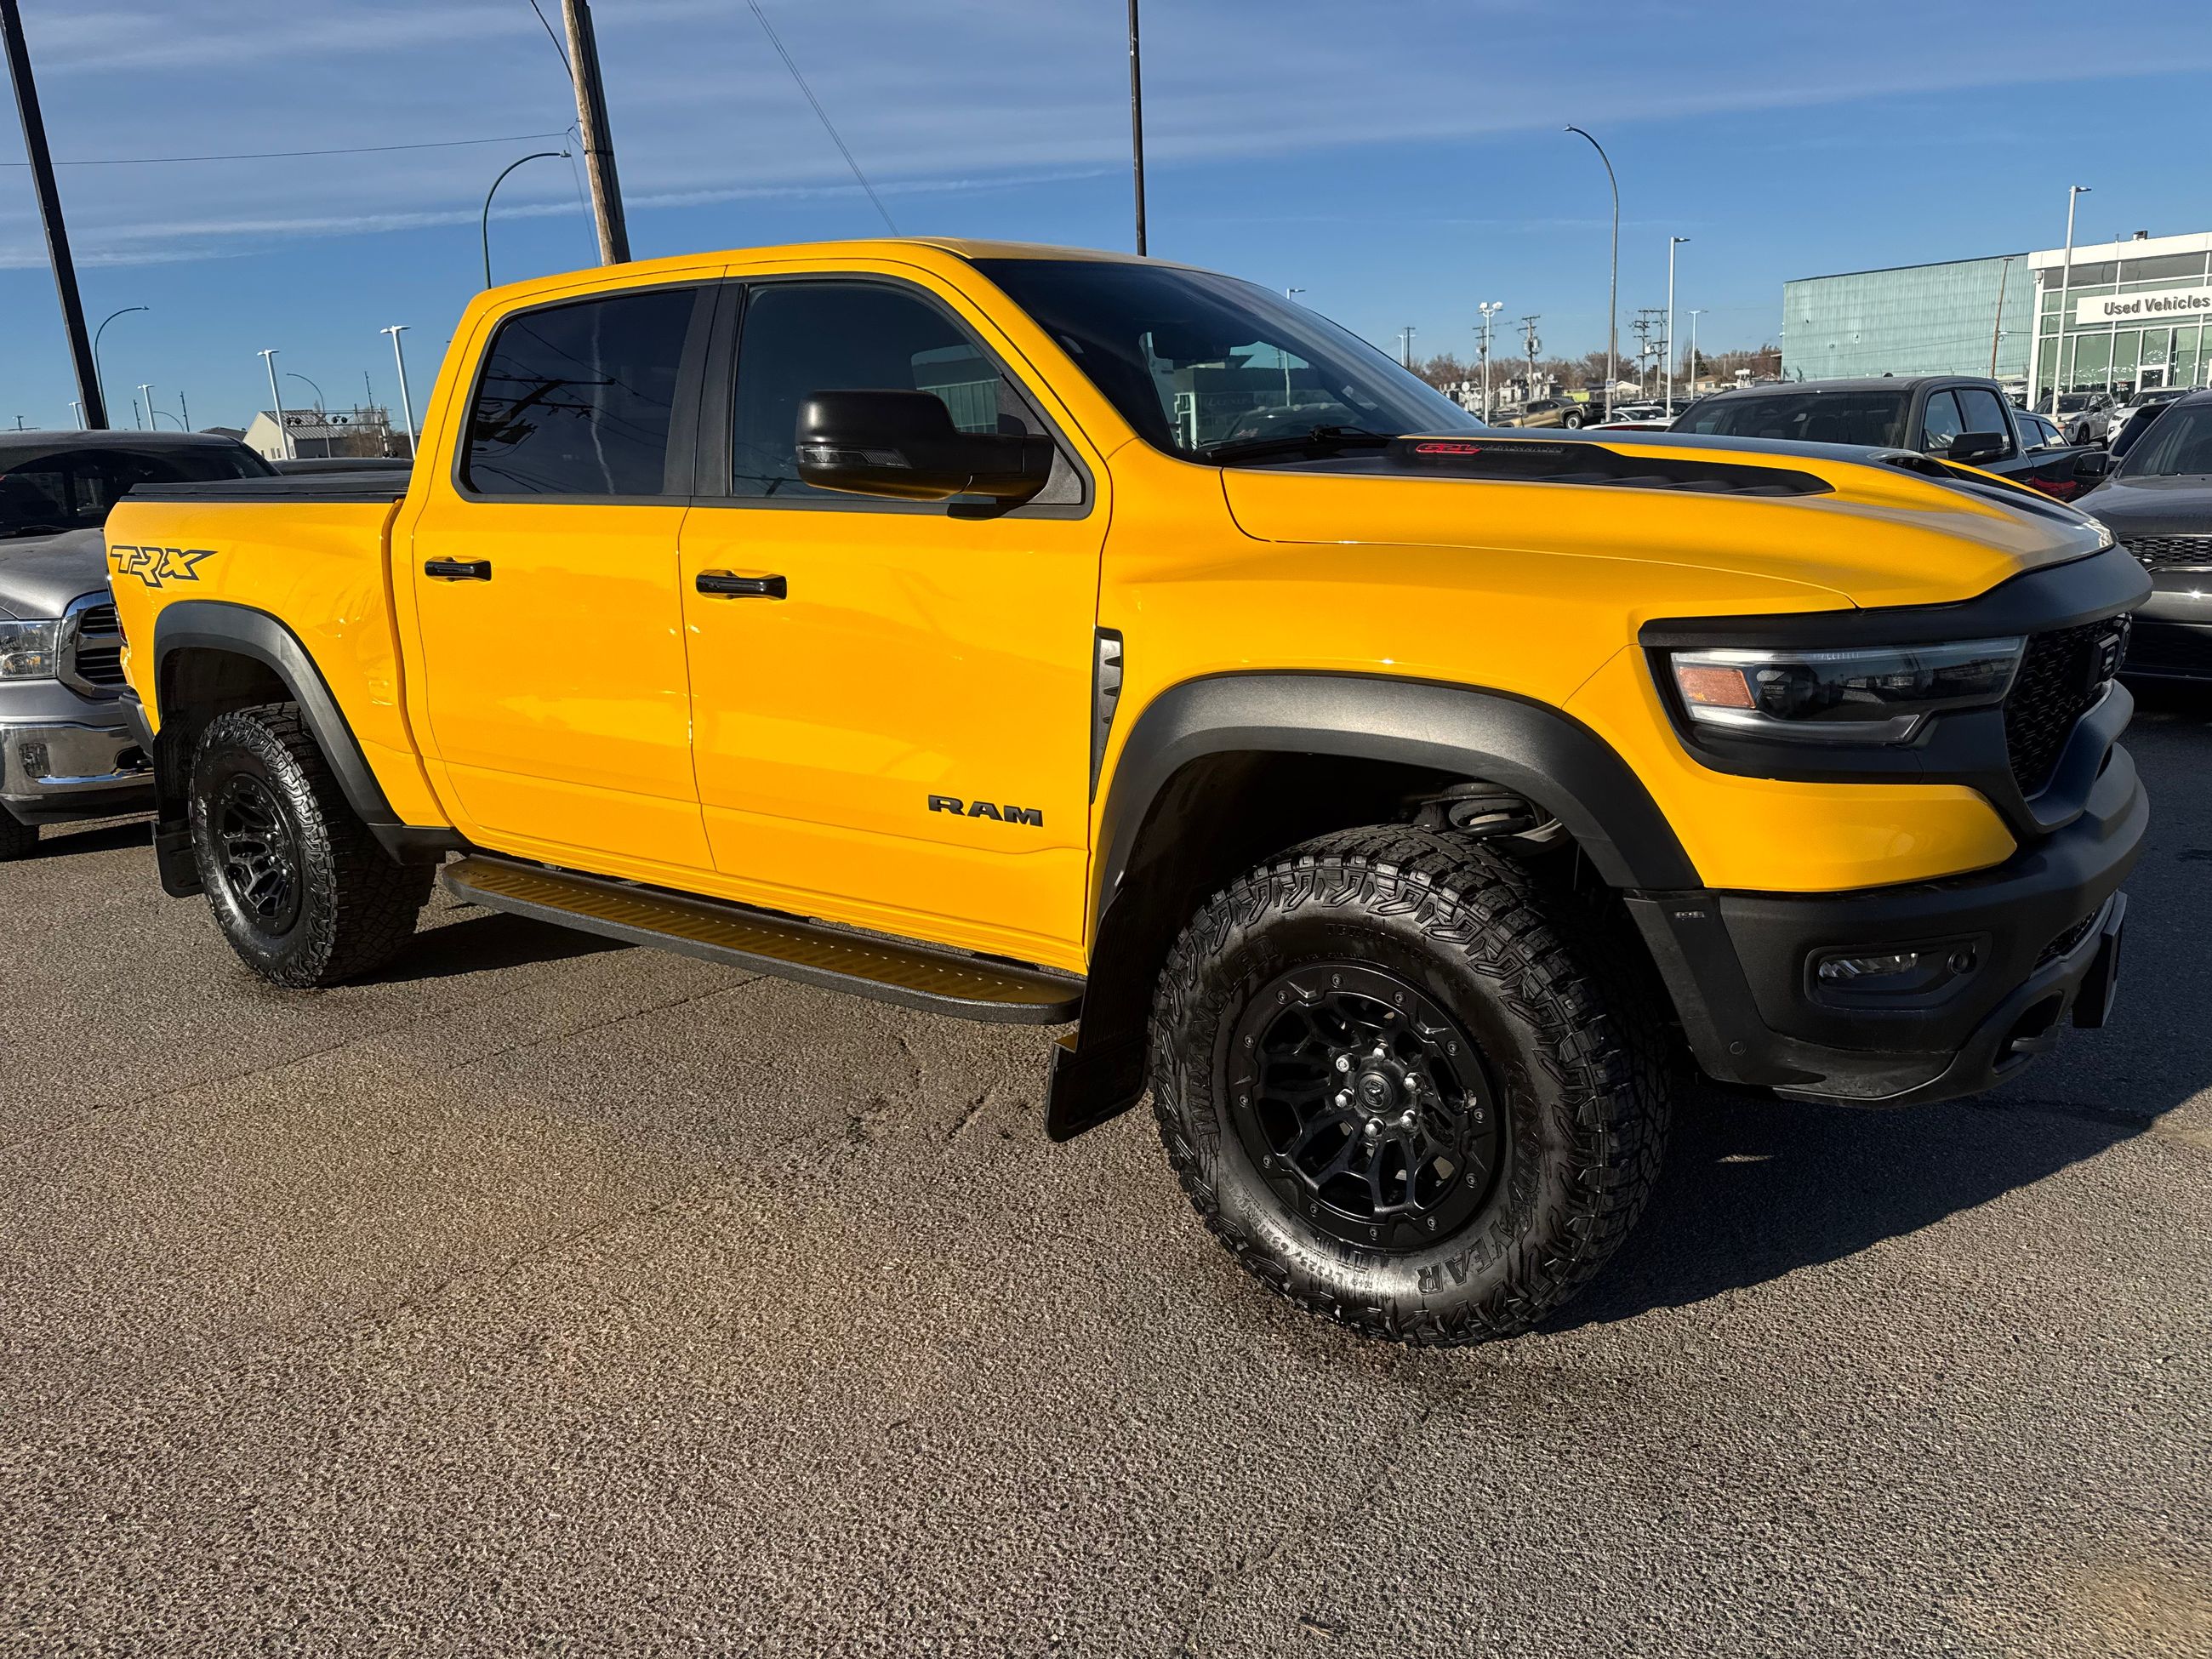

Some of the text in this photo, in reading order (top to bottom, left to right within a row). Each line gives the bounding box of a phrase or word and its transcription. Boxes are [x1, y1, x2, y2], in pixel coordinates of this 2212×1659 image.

[2104, 295, 2211, 316] Used Vehicles
[110, 545, 219, 588] TRX
[928, 795, 1043, 827] RAM
[1188, 934, 1282, 1138] WRANGLER
